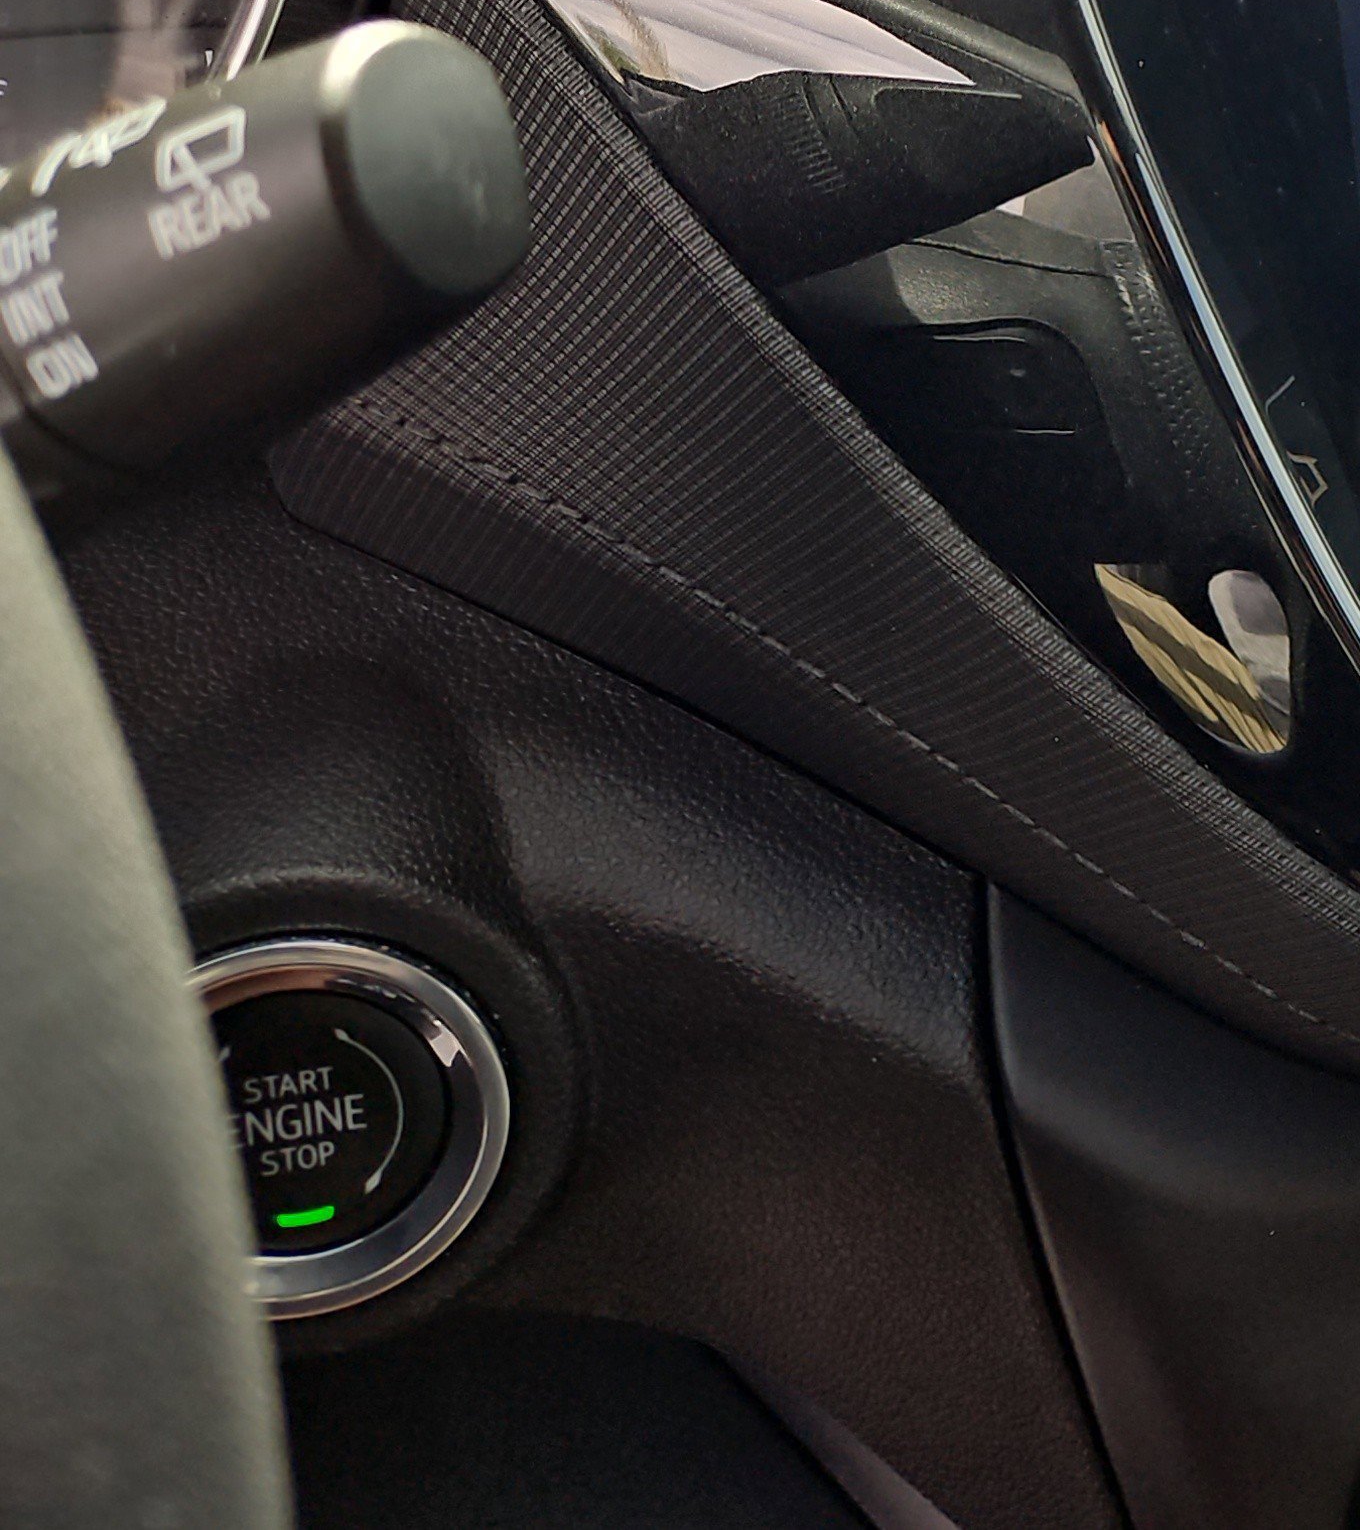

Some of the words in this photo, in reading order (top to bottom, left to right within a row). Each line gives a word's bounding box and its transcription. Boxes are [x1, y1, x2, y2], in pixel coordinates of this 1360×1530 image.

[0, 208, 59, 284] OFF
[148, 171, 271, 260] REAR
[0, 271, 70, 347] INT
[26, 333, 98, 401] ON
[243, 1067, 333, 1105] START
[261, 1141, 336, 1176] STOP
